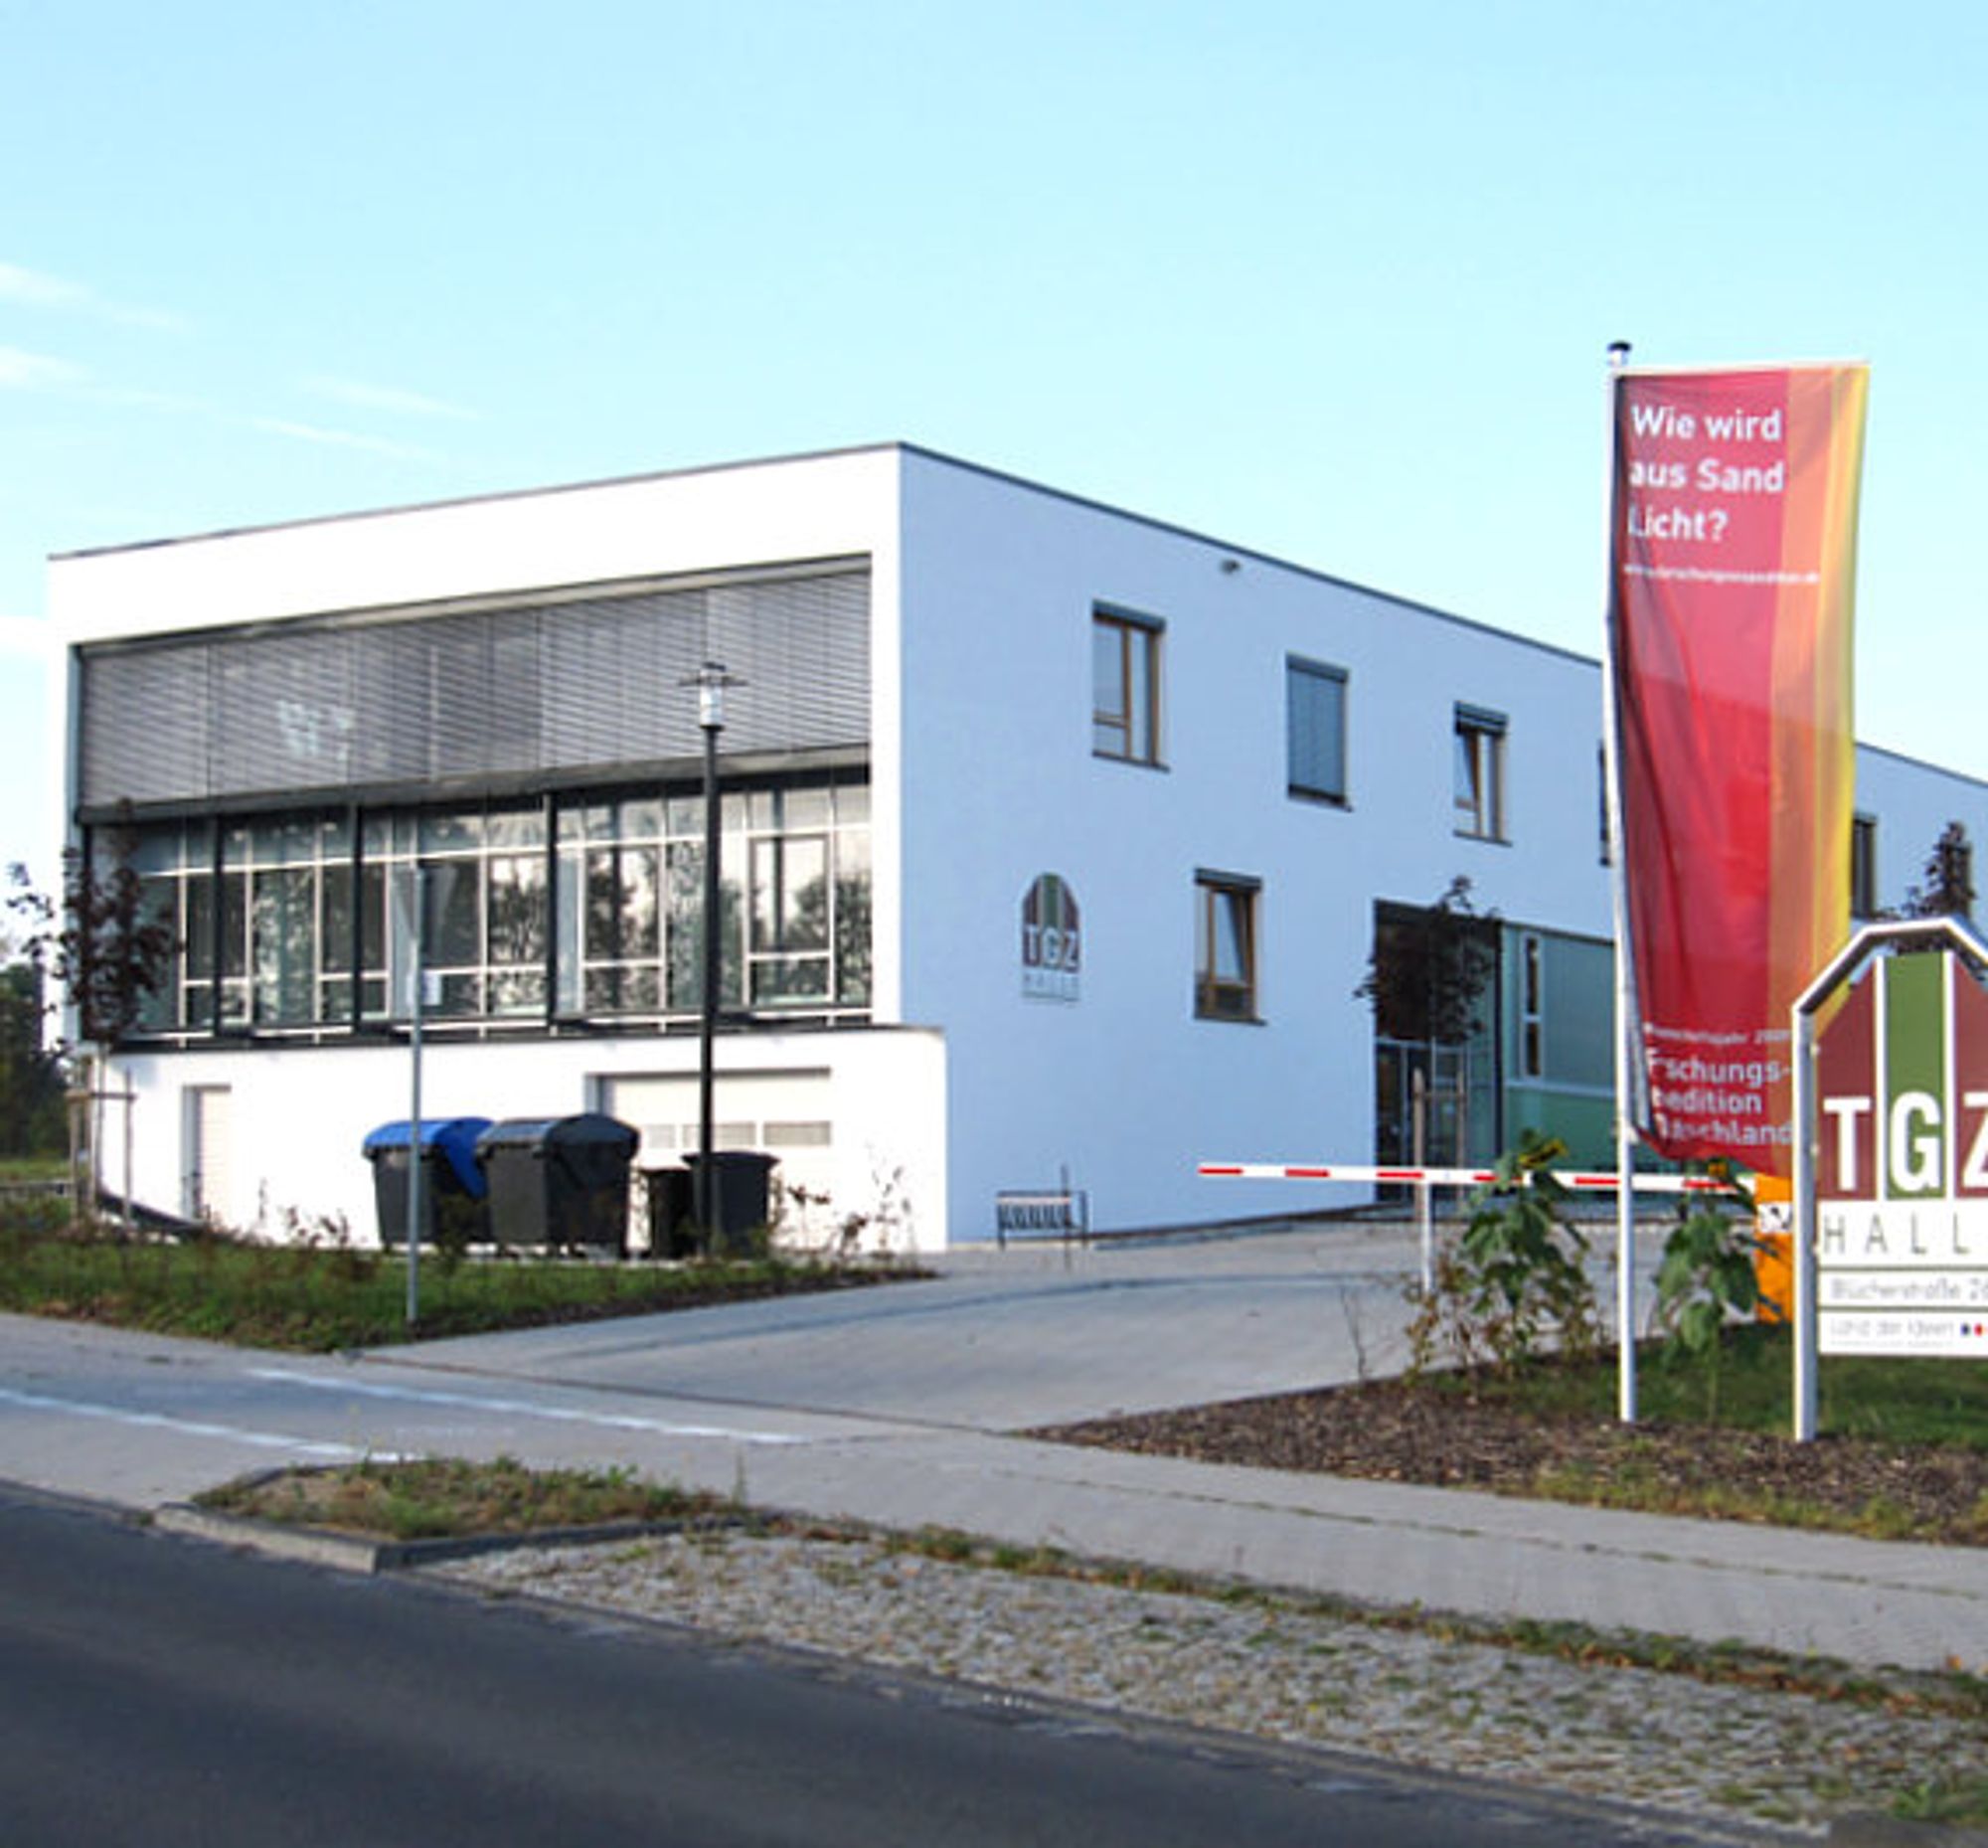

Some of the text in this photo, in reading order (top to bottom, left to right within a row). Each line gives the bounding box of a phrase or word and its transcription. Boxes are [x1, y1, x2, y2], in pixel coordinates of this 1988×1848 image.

[1630, 405, 1782, 441] Wie wird
[1629, 457, 1785, 493] aus Sand
[1627, 503, 1729, 543] Licht?
[1023, 924, 1078, 968] TGZ
[1823, 1212, 1970, 1256] HALL
